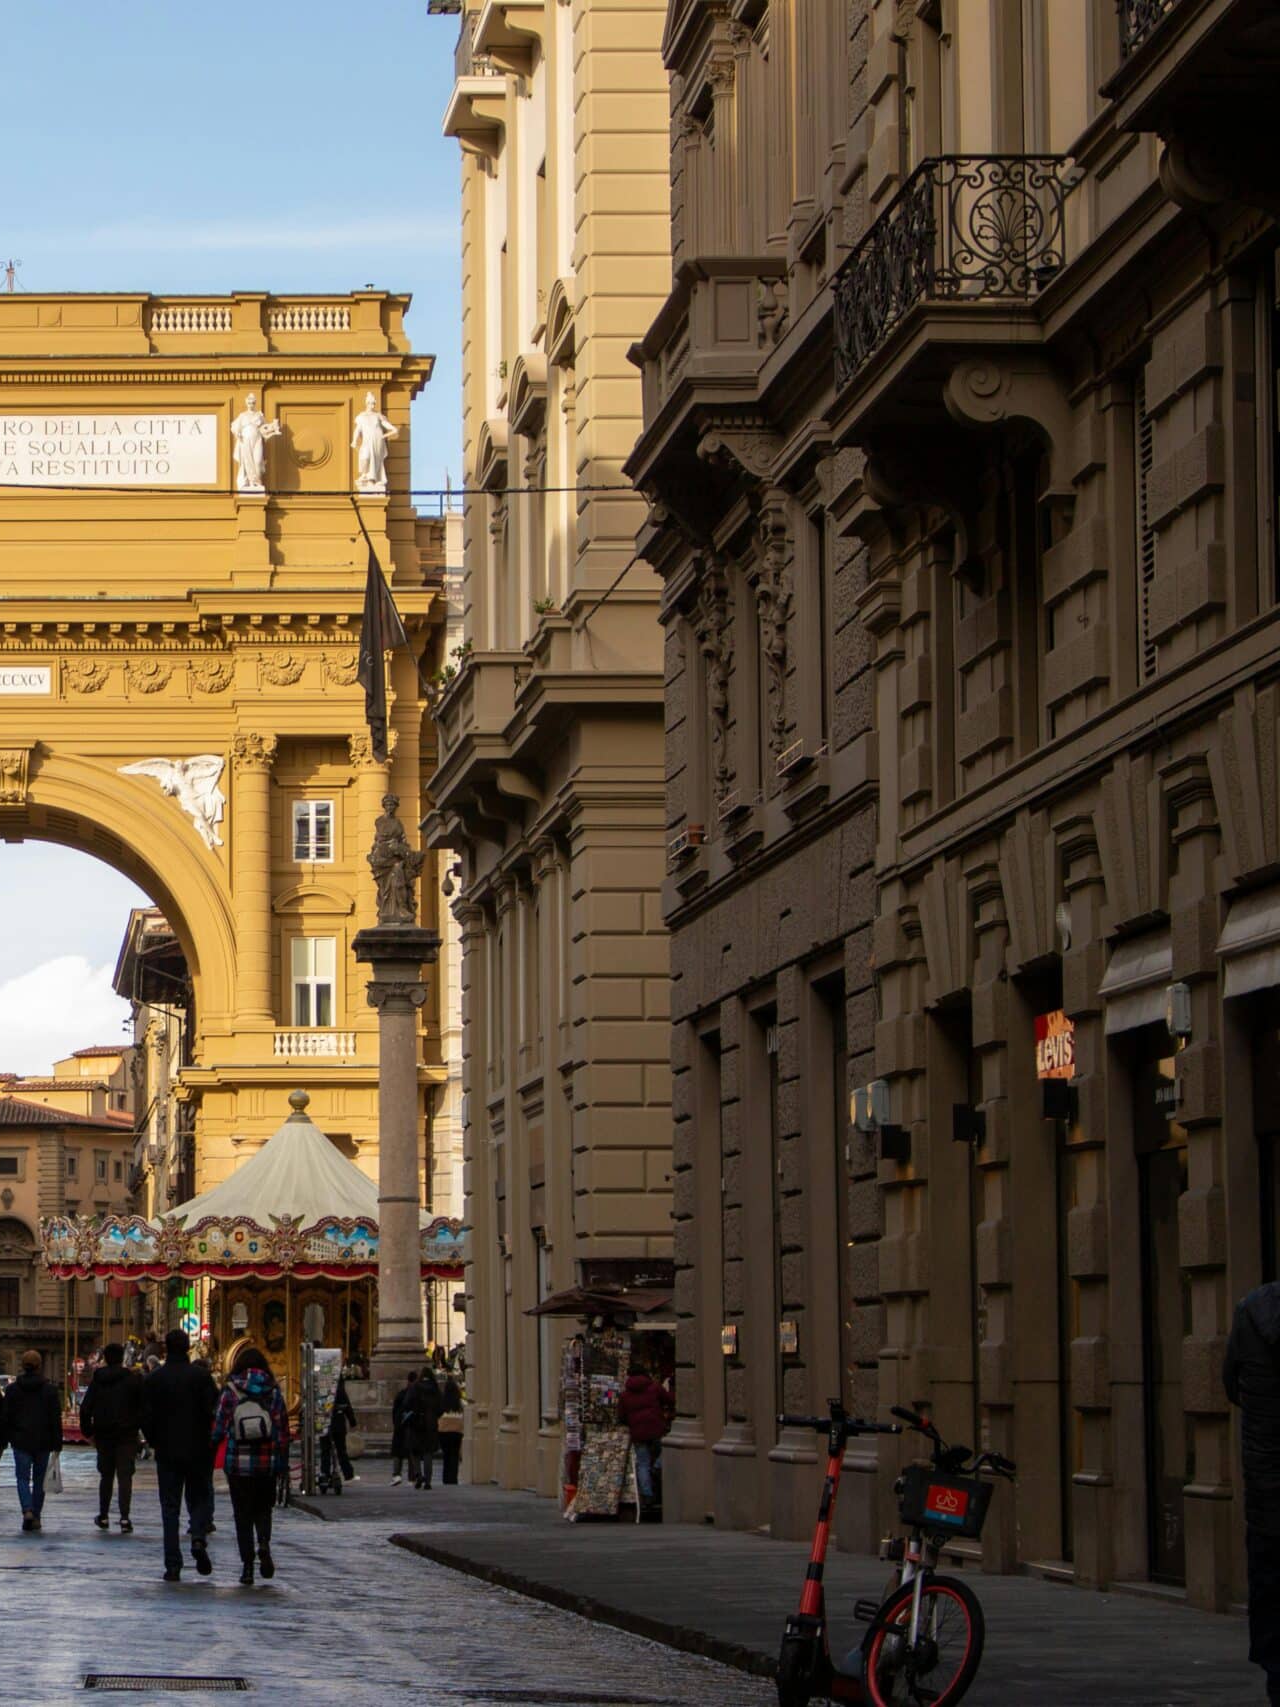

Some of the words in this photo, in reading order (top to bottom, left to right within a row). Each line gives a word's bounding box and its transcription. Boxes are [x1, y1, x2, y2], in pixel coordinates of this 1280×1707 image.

[44, 420, 122, 436] DELLA
[28, 439, 170, 457] SQUALLORE
[31, 459, 170, 476] RESTITUITO
